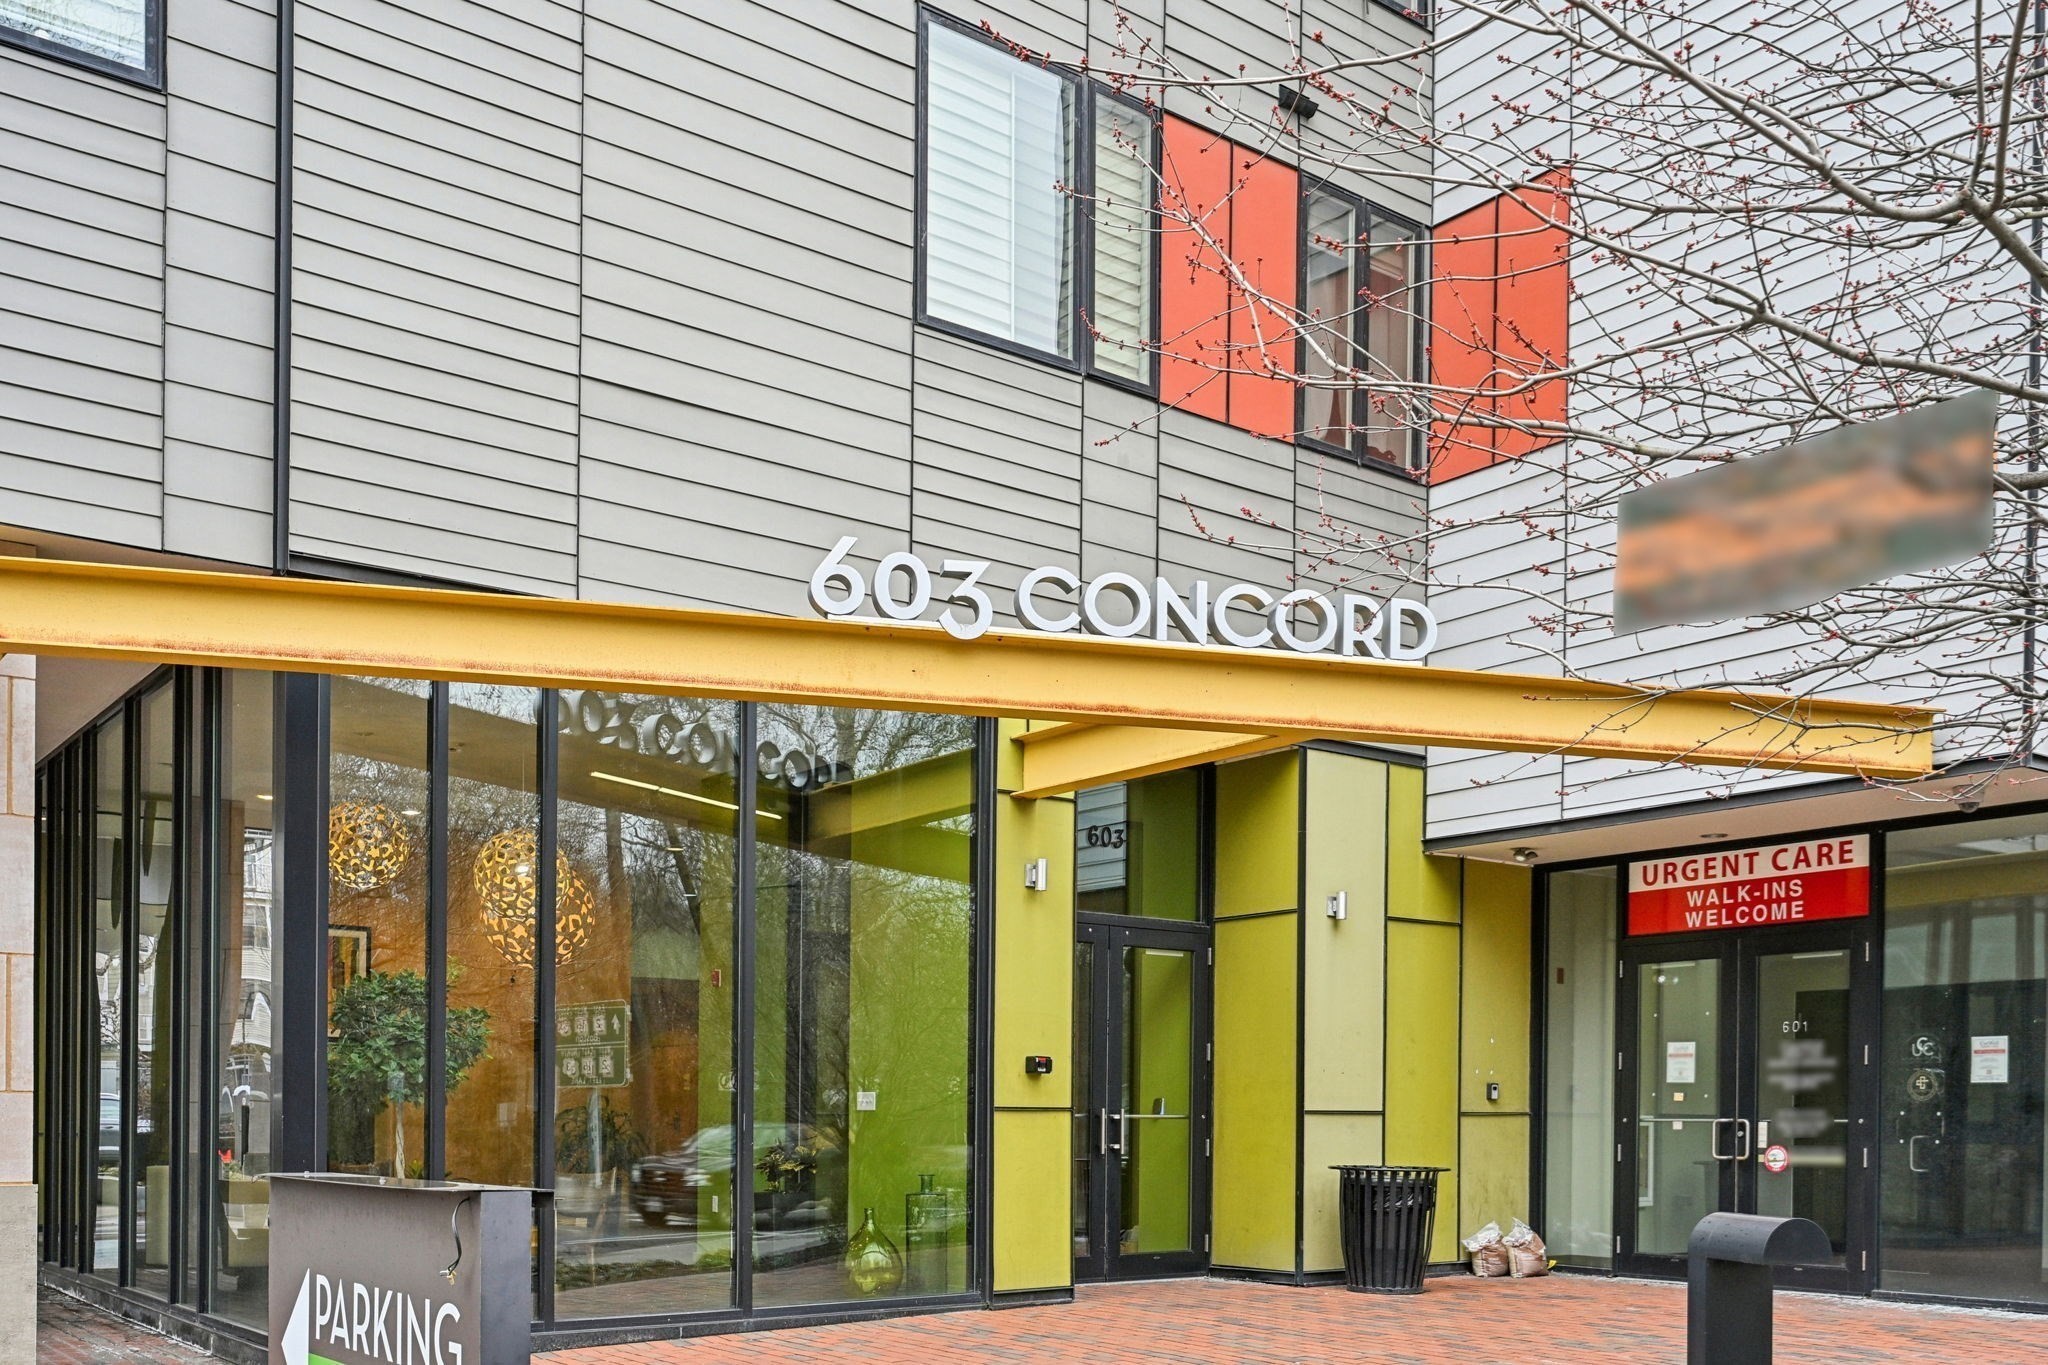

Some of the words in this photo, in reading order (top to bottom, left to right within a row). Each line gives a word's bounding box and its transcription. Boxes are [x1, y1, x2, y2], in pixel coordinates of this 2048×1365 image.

[807, 535, 993, 640] 603
[1013, 565, 1438, 660] CONCORD
[1087, 825, 1125, 849] 603
[1642, 851, 1760, 887] URGENT
[1771, 839, 1854, 871] CARE
[1686, 879, 1803, 908] WALK-INS
[1685, 900, 1805, 929] WELCOME
[1782, 1020, 1808, 1033] 601
[315, 1273, 462, 1365] PARKING
